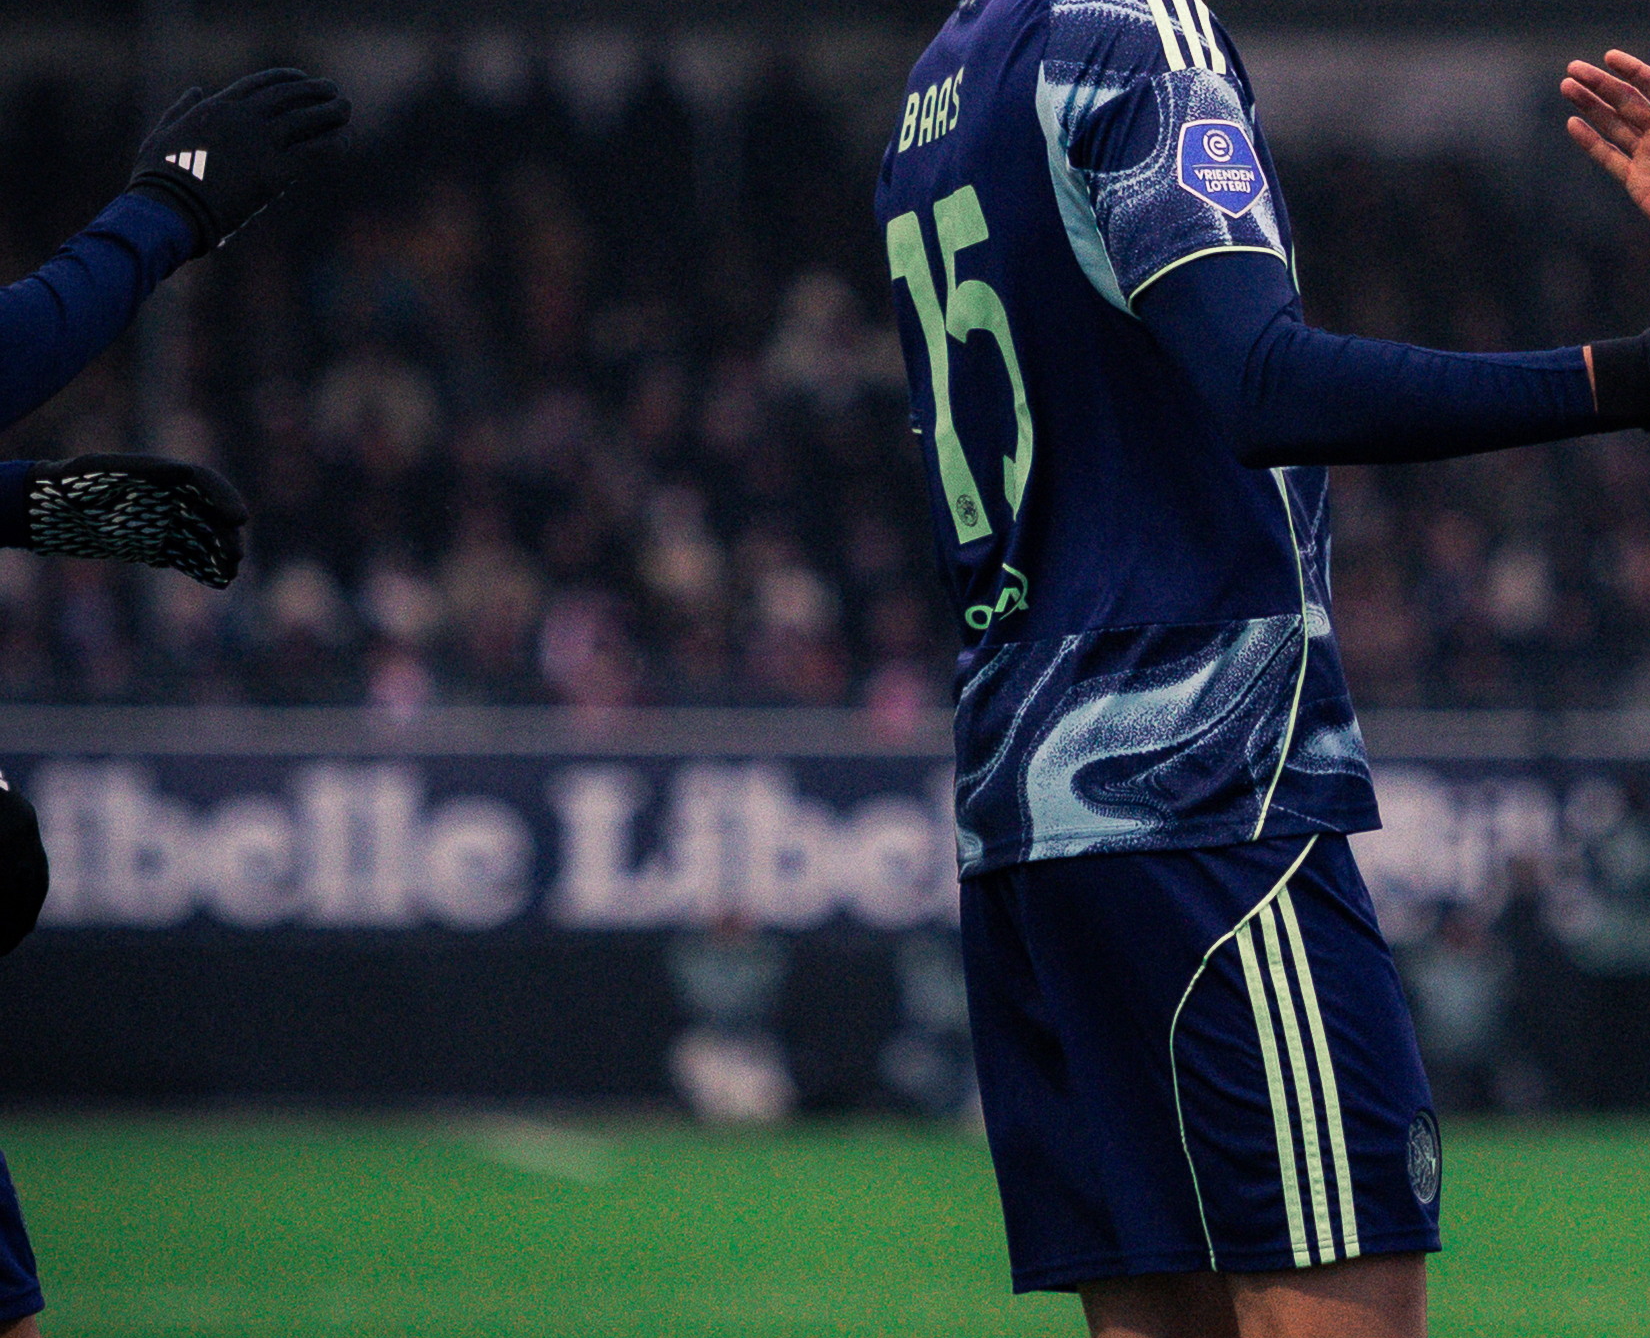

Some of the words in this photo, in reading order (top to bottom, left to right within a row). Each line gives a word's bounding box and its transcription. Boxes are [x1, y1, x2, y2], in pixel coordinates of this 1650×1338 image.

[898, 66, 965, 153] BAAS
[1194, 169, 1255, 181] VRIENDEN
[1205, 180, 1251, 193] LOTERIJ
[886, 184, 1034, 544] 15
[36, 763, 538, 927] ibelle
